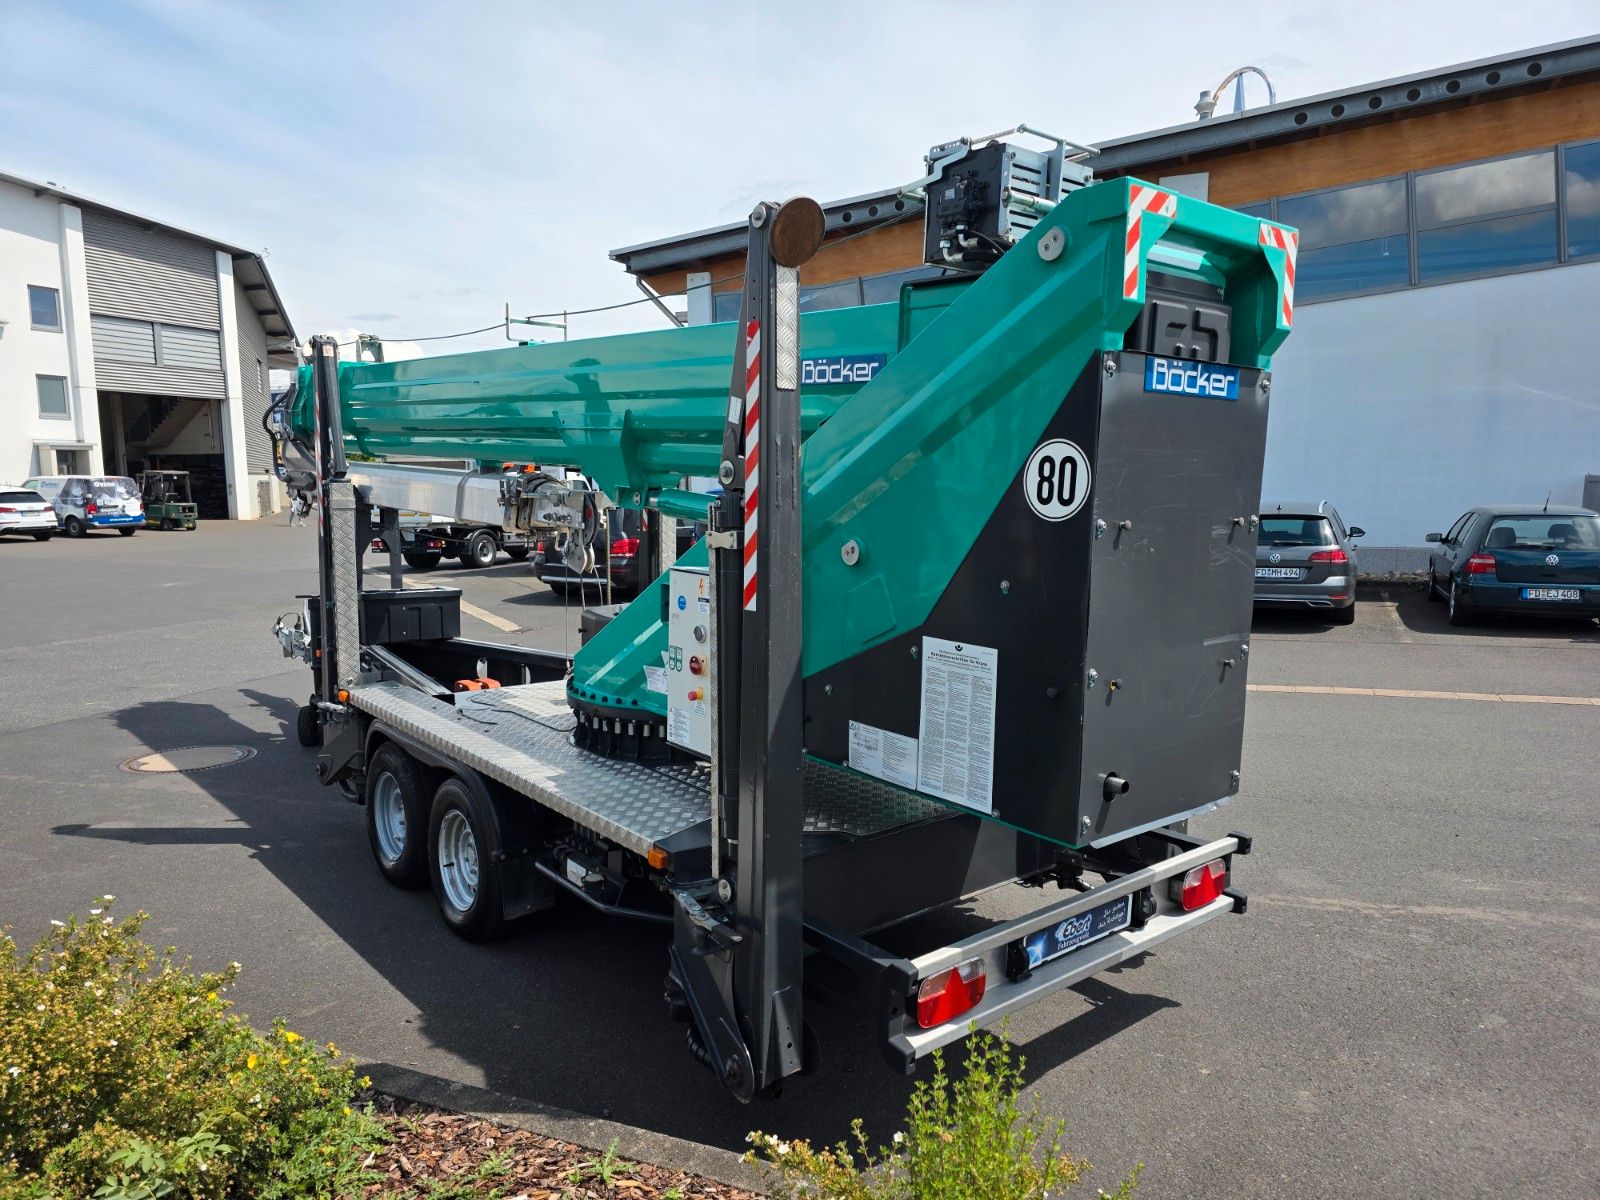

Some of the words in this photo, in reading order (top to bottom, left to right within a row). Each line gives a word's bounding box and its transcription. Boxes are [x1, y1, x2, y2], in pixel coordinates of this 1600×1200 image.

[802, 358, 879, 383] Böcker
[1152, 358, 1235, 397] Böcker
[1037, 455, 1077, 507] 80
